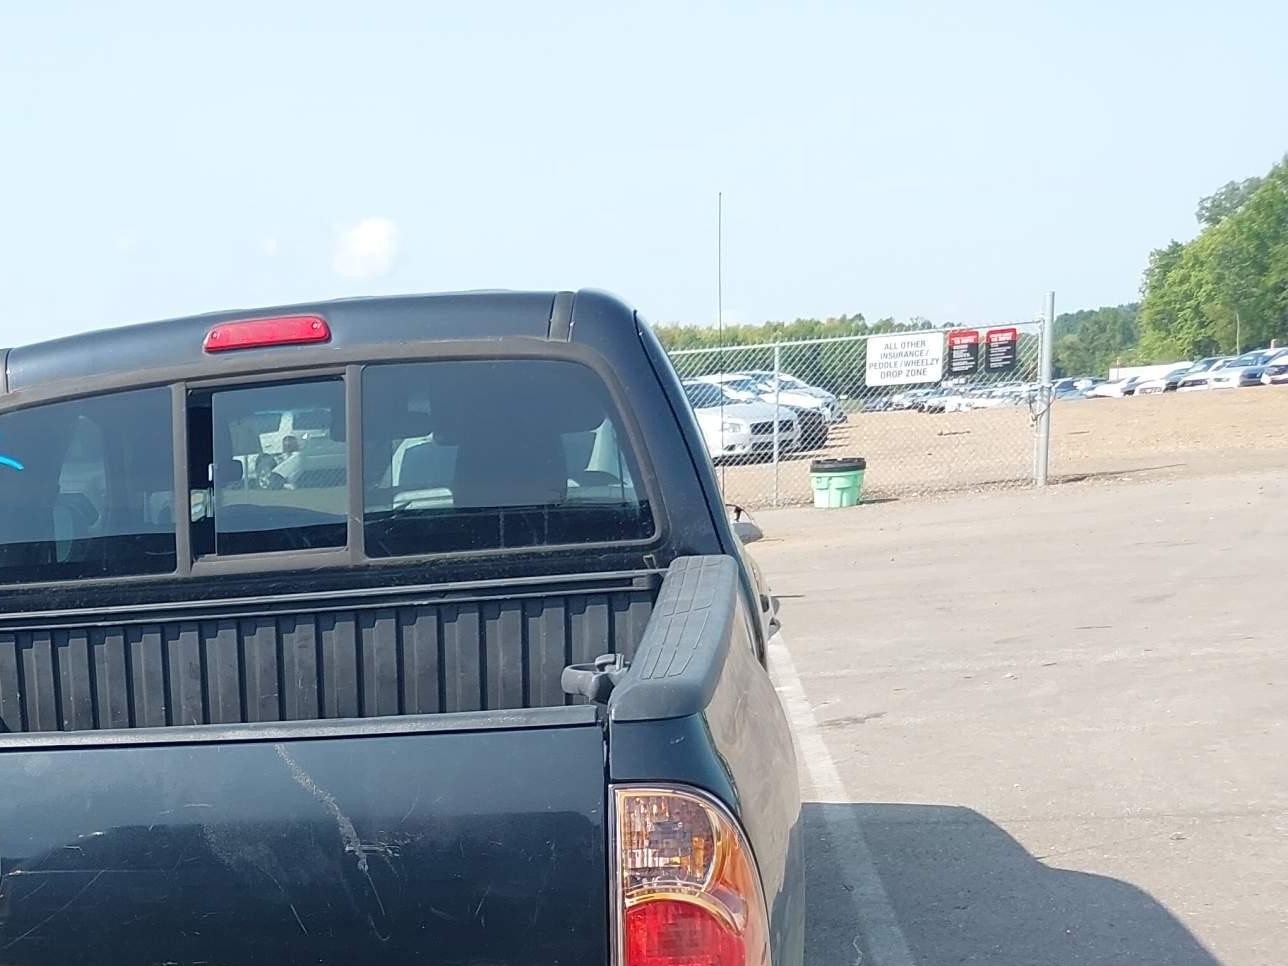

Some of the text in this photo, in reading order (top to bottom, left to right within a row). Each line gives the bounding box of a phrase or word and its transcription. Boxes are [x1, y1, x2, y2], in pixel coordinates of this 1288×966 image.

[884, 340, 926, 351] ALL OTHER
[880, 368, 928, 380] DROP ZONE
